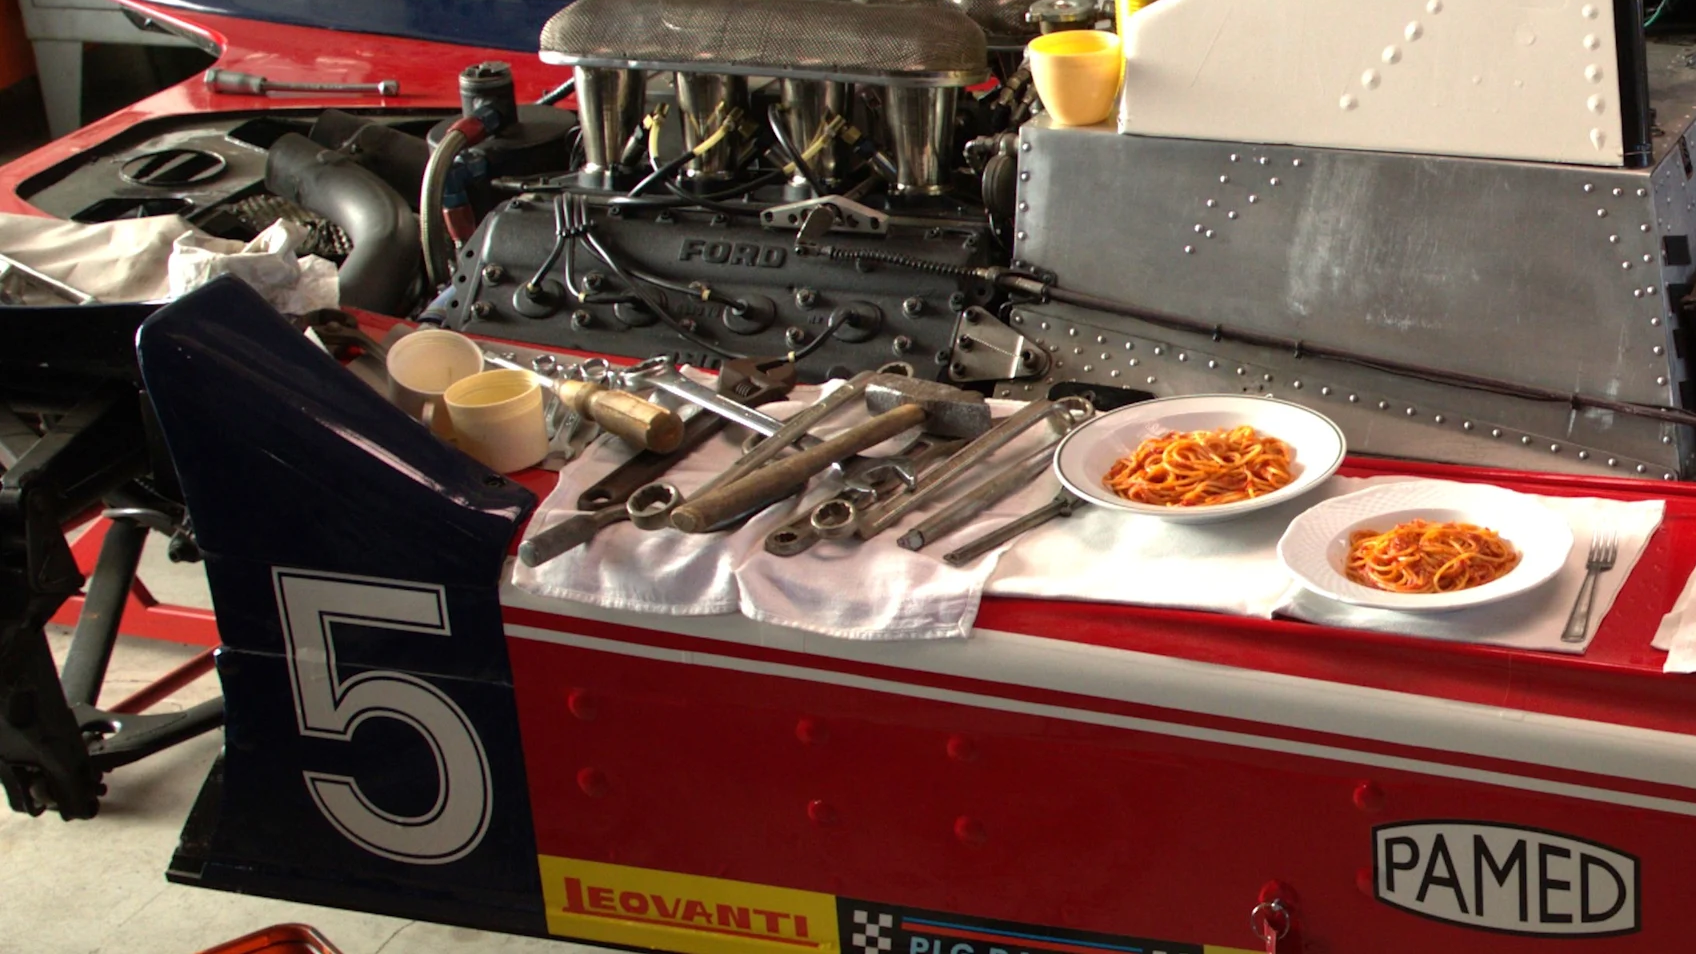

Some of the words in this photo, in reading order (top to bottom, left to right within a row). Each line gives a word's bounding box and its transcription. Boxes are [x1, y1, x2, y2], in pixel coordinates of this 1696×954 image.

[678, 238, 788, 268] FORD
[272, 566, 493, 865] 5
[562, 876, 810, 941] LEOVANTI
[1384, 833, 1627, 924] PAMED
